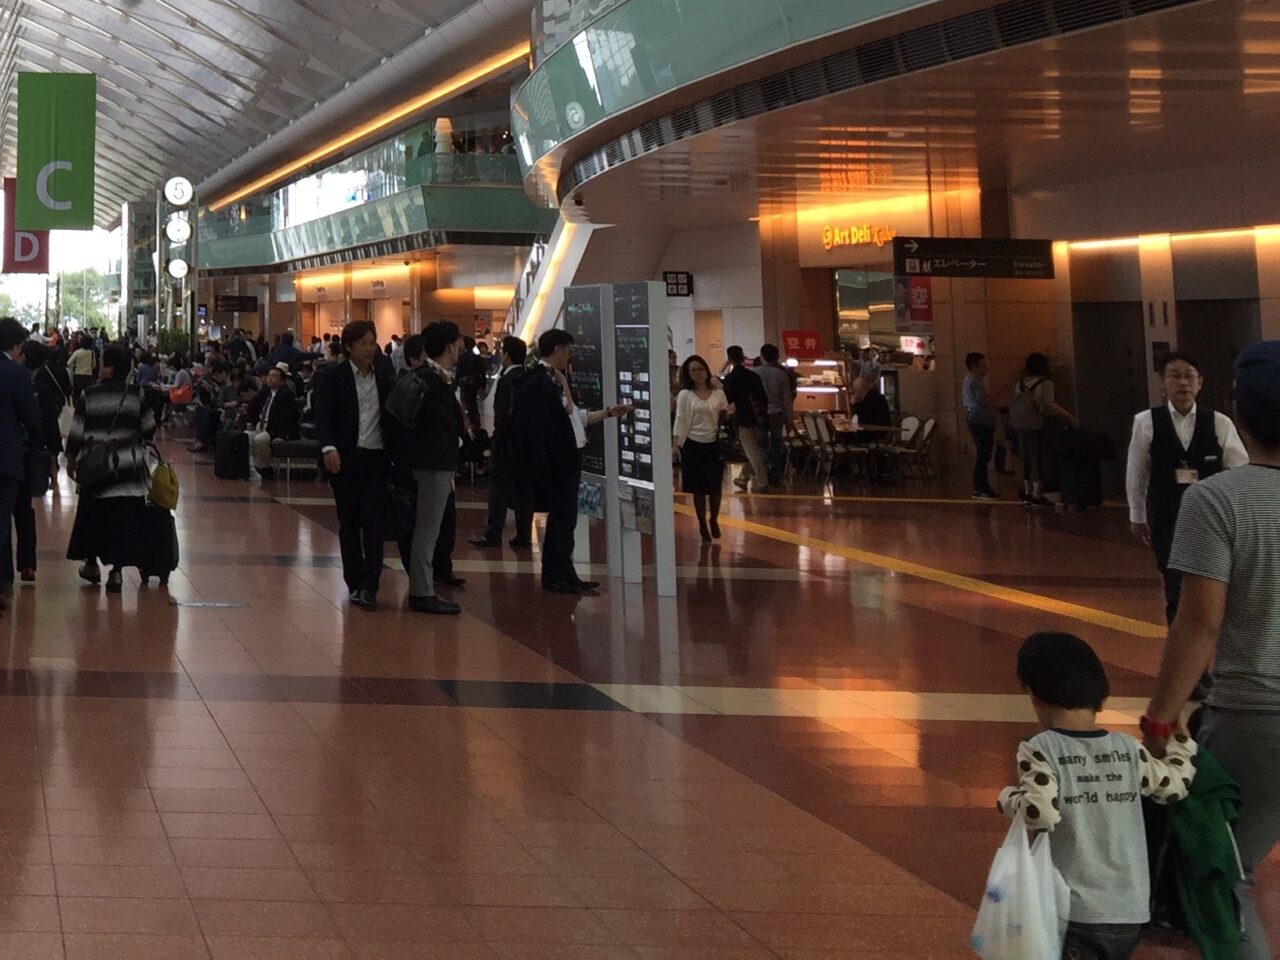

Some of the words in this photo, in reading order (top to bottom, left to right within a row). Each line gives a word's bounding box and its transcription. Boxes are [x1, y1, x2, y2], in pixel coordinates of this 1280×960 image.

[36, 160, 72, 211] C
[173, 182, 185, 200] 5
[833, 228, 850, 246] Art
[851, 224, 870, 245] Deli
[14, 231, 40, 262] D
[933, 259, 988, 270] エレベーター
[1058, 753, 1087, 766] many
[1094, 749, 1132, 764] smiles
[1077, 773, 1101, 783] make
[1105, 772, 1123, 782] the
[1063, 791, 1099, 805] world
[1105, 791, 1138, 803] happy
